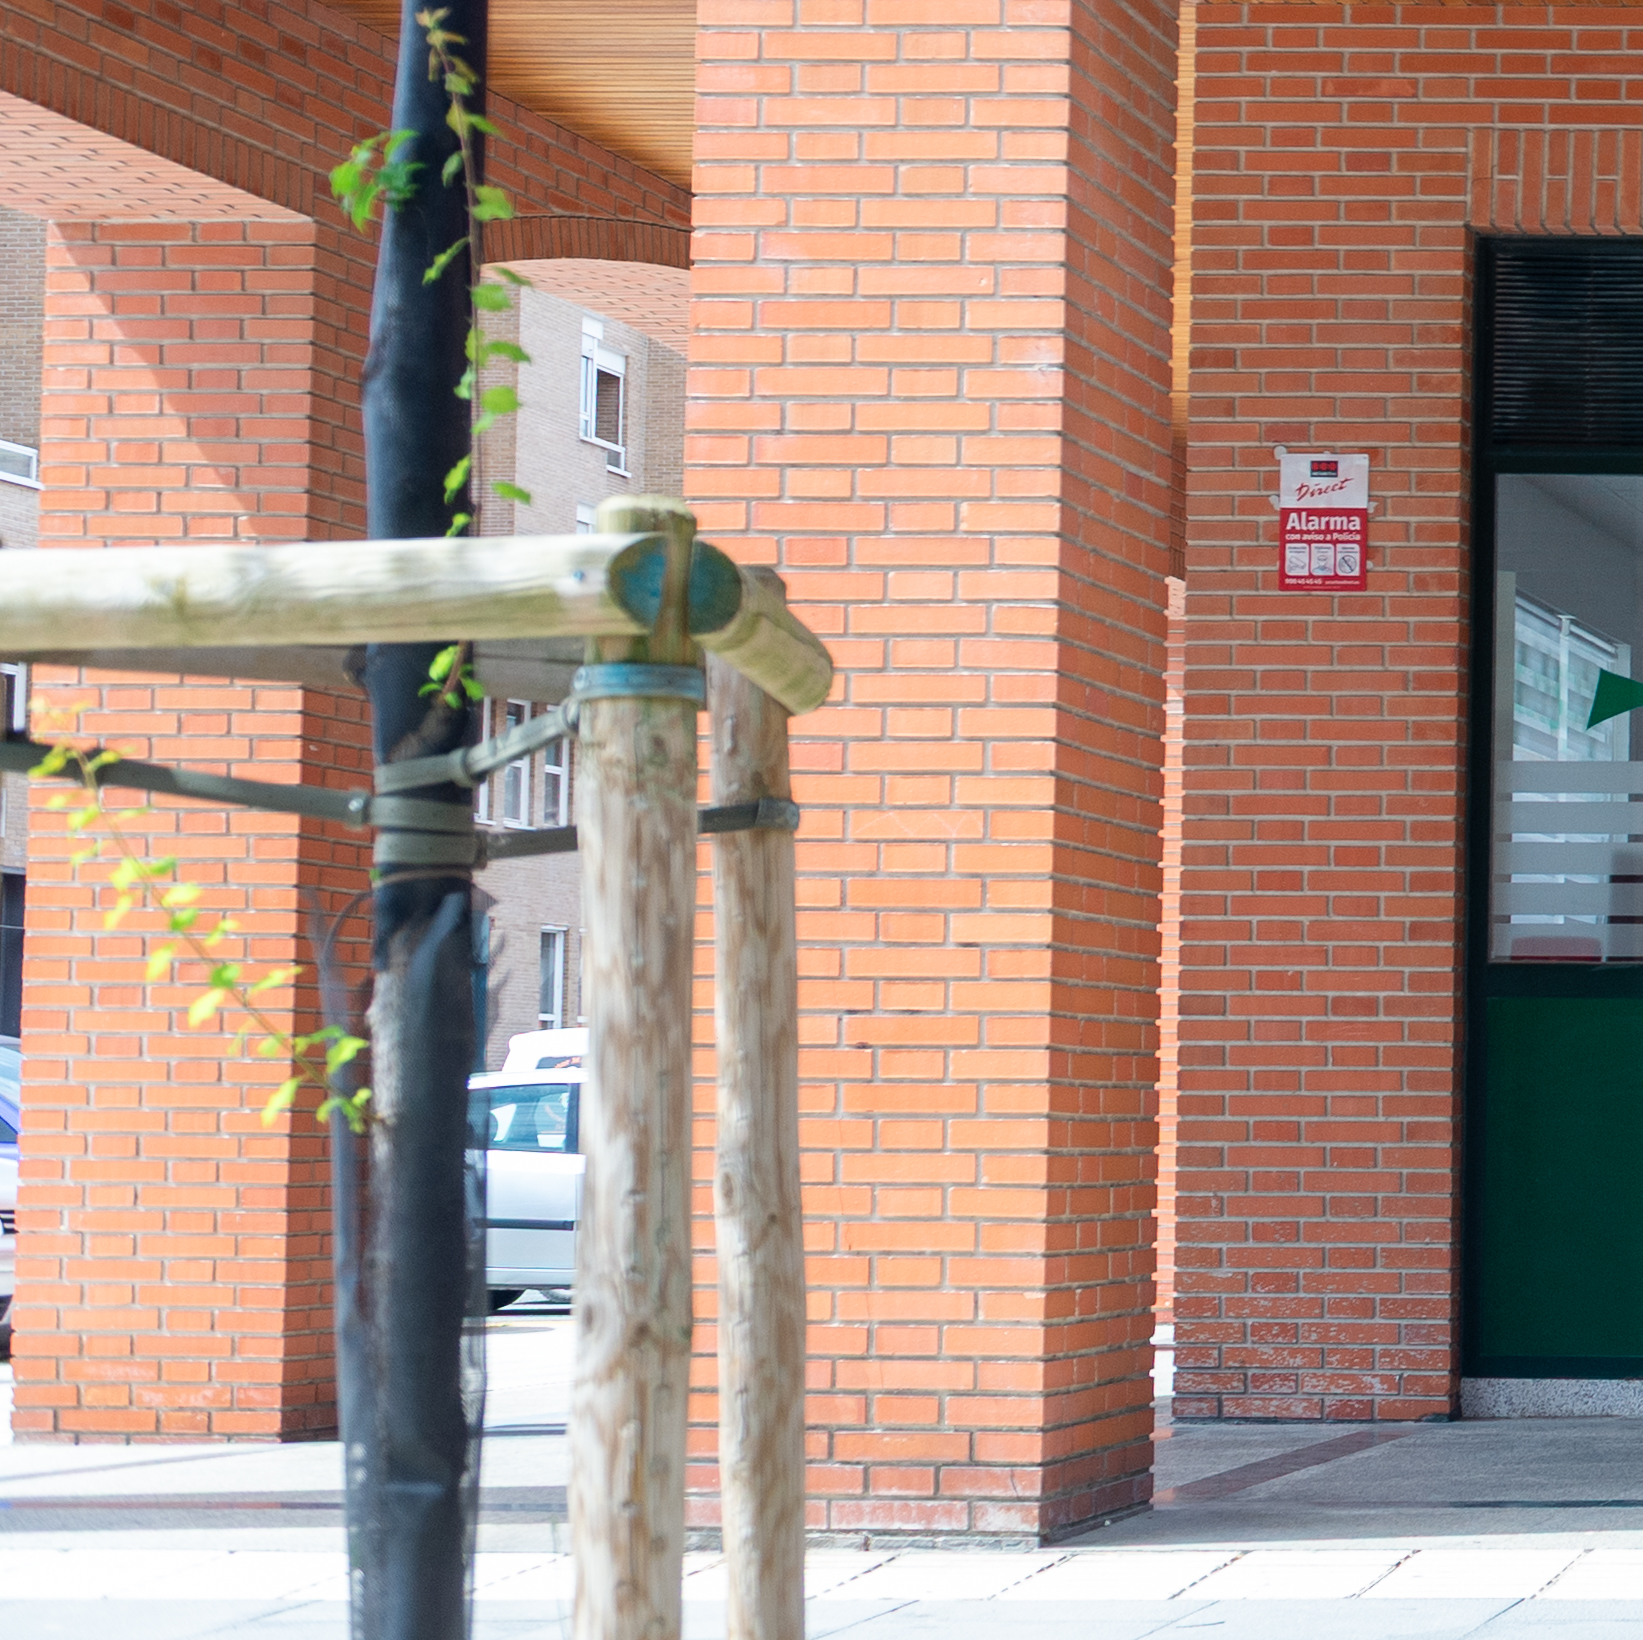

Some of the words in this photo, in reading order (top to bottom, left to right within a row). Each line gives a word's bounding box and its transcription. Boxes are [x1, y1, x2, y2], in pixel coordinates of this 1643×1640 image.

[1296, 478, 1354, 501] Direct
[1286, 512, 1361, 531] Alarma
[1302, 532, 1324, 541] aviso
